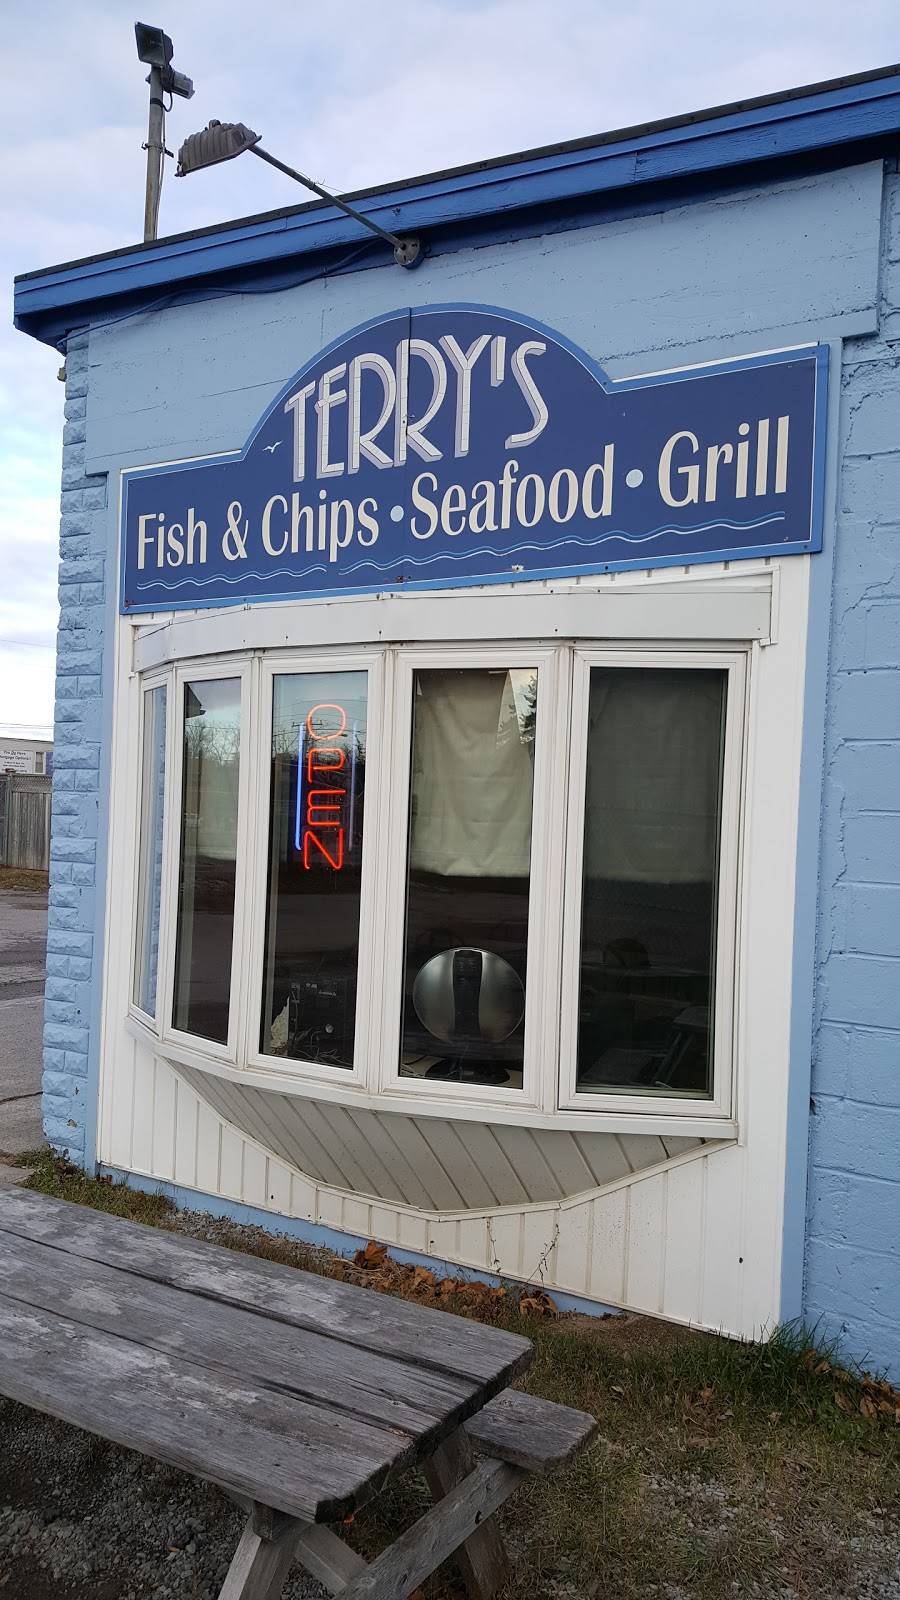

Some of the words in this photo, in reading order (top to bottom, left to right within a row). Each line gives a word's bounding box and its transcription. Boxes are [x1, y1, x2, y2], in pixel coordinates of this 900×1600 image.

[284, 335, 549, 482] TERRY'S
[137, 507, 207, 569] Fish
[222, 501, 249, 560] &
[262, 489, 379, 562] Chips
[410, 444, 615, 540] Seafood
[658, 416, 789, 507] Grill
[304, 704, 347, 869] OPEN
